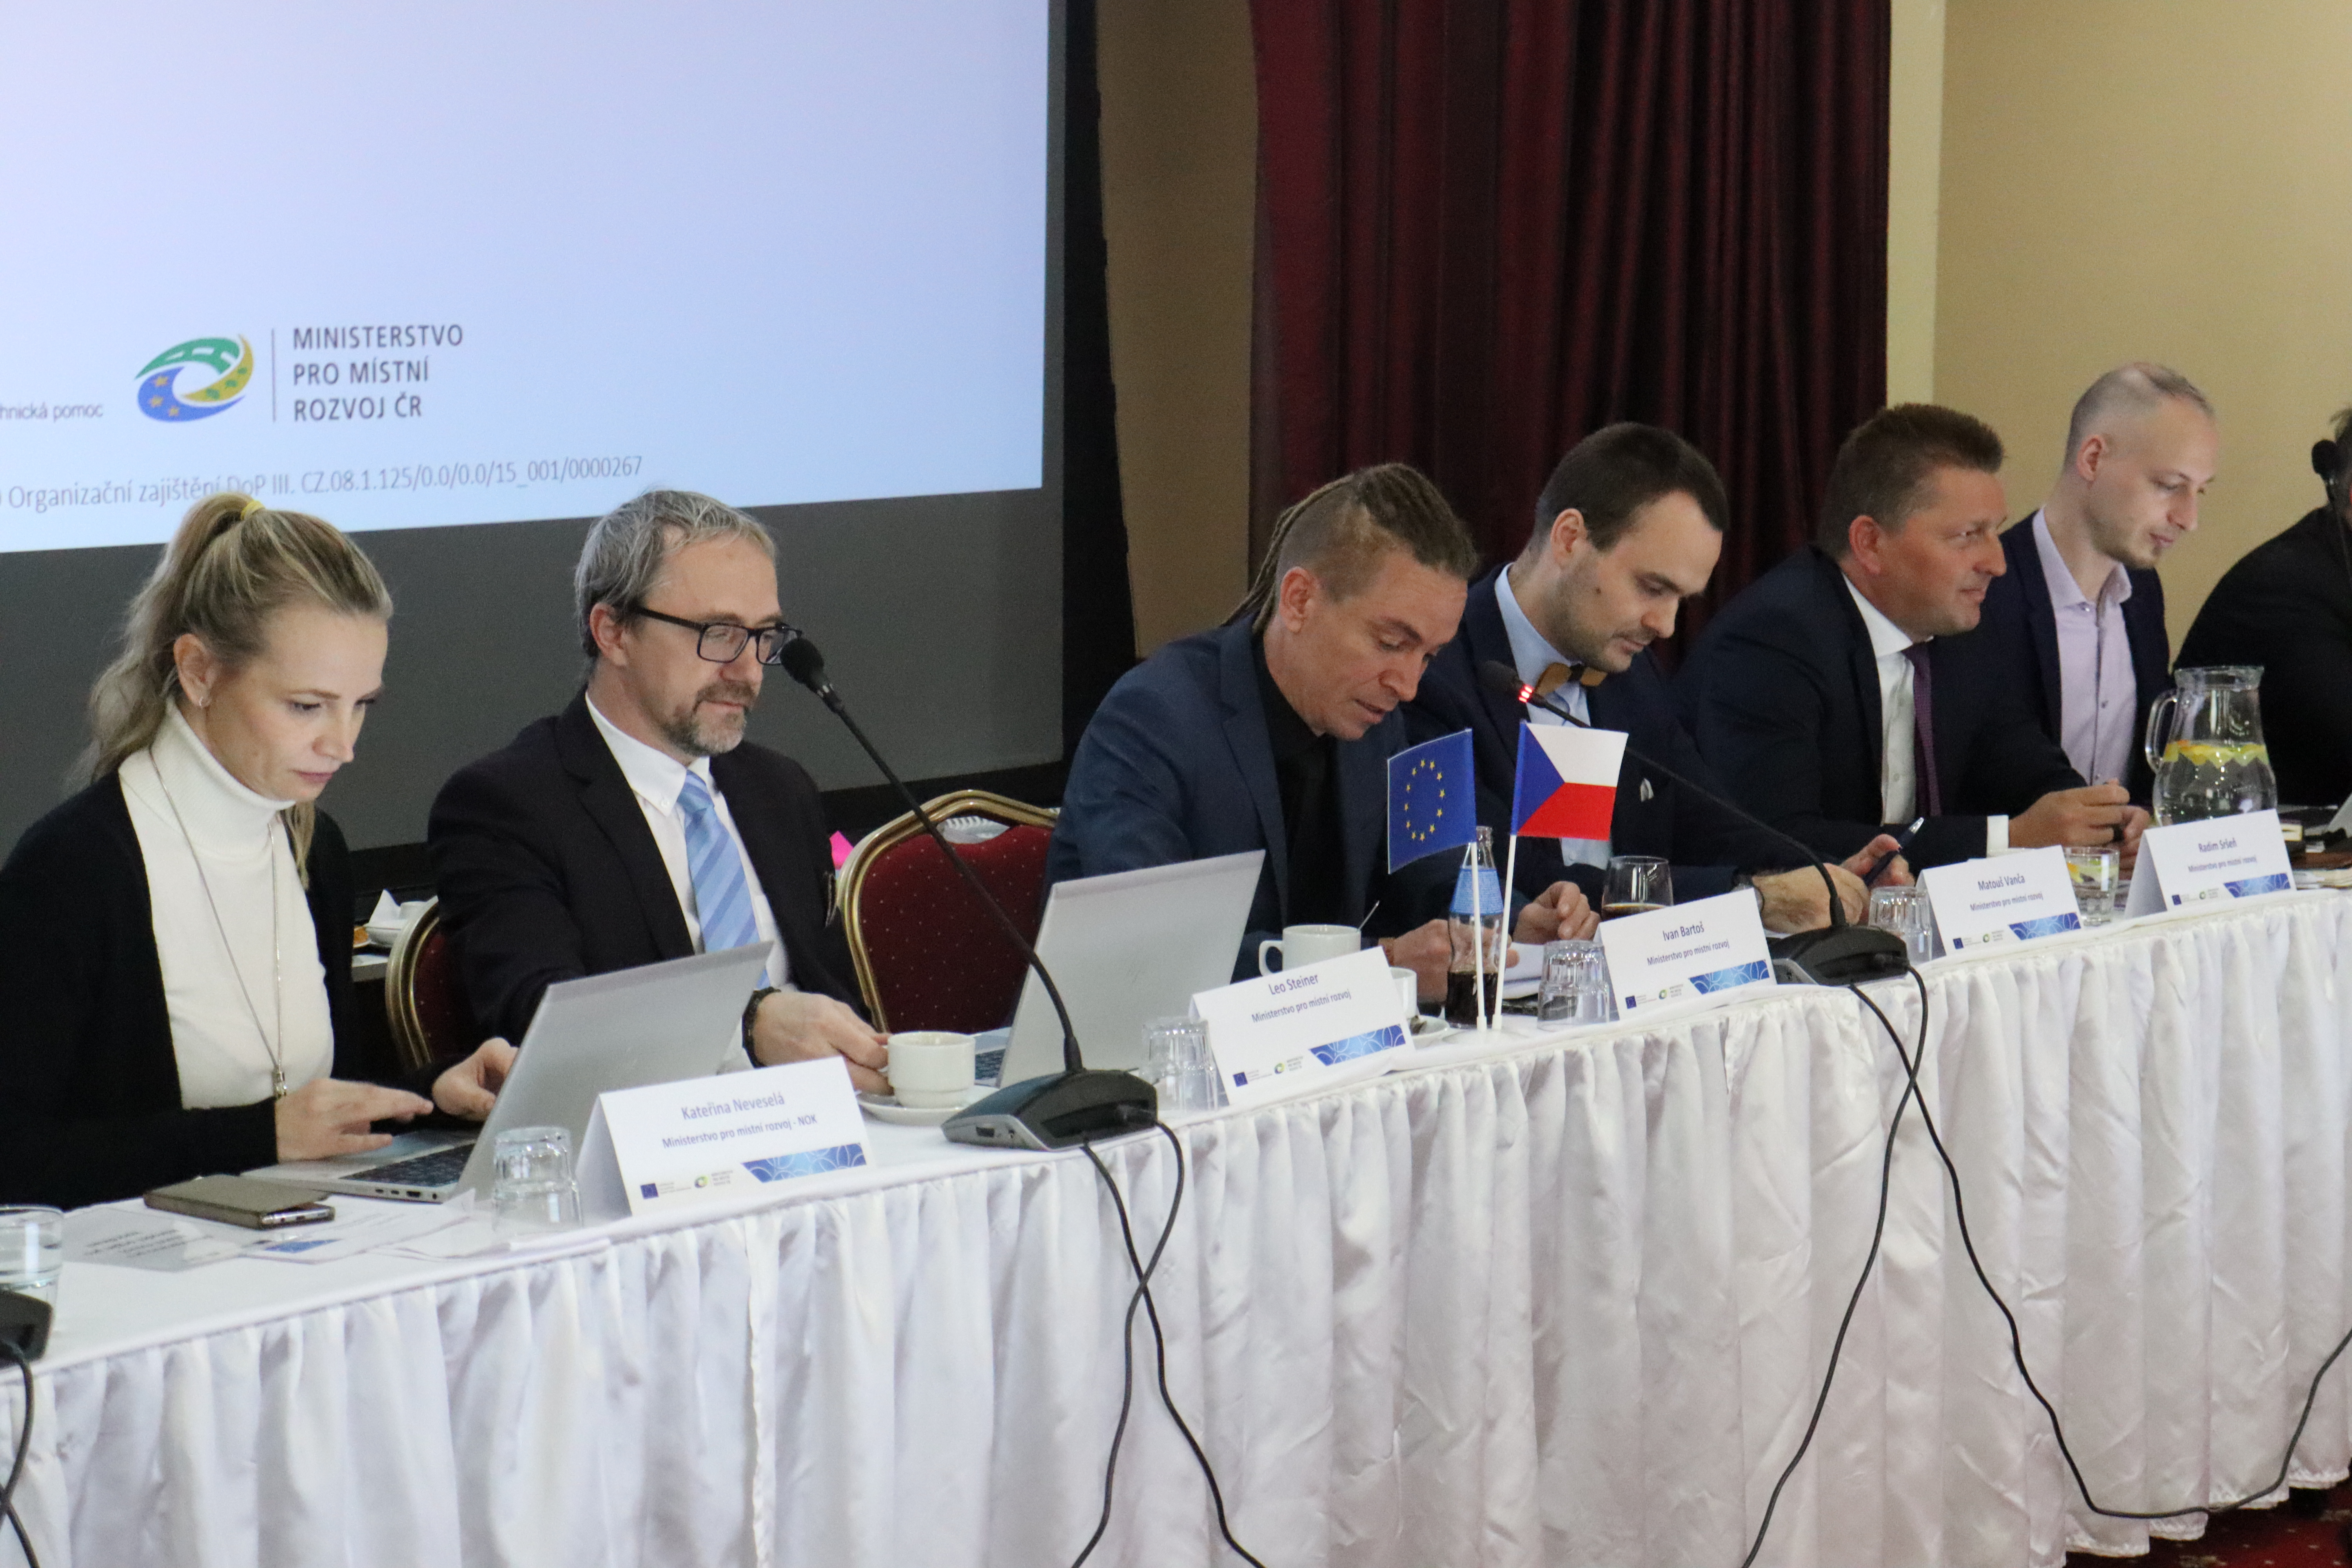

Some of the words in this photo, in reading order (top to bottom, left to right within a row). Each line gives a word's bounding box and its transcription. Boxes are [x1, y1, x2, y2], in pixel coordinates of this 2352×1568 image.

[294, 324, 463, 350] MINISTERSTVO
[294, 362, 339, 386] PRO
[350, 355, 429, 384] MÍSTNÍ
[53, 403, 104, 423] pomoc
[294, 396, 385, 422] ROZVOJ
[394, 391, 422, 418] ČR
[8, 479, 132, 514] Organizační
[272, 474, 296, 495] III.
[301, 456, 642, 494] CZ.08.1.125/0.0/0.0/15_001/0000267
[2198, 841, 2219, 853] Radim
[1978, 877, 2004, 891] Matouš
[2004, 873, 2025, 886] Vanča
[1970, 900, 2002, 911] Ministerstvo
[2002, 899, 2011, 908] pro
[2011, 894, 2027, 904] místní
[2027, 891, 2043, 900] rozvoj
[1662, 929, 1679, 941] Ivan
[1680, 921, 1704, 937] Bartoš
[1647, 952, 1682, 966] Ministerstvo
[1683, 949, 1693, 958] pro
[1694, 942, 1711, 955] místní
[1712, 939, 1730, 950] rozvoj
[1269, 984, 1286, 995] Leo
[1286, 975, 1319, 991] Steiner
[1251, 1006, 1294, 1023] Ministerstvo
[1296, 1002, 1308, 1013] pro
[1308, 994, 1330, 1007] místní
[1330, 989, 1352, 1002] rozvoj
[681, 1102, 732, 1120] Kateřina
[732, 1092, 785, 1112] Neveselá
[662, 1133, 719, 1149] Ministerstvo
[720, 1130, 735, 1141] pro
[737, 1123, 764, 1136] místní
[765, 1119, 792, 1131] rozvoj
[798, 1114, 817, 1126] NOK
